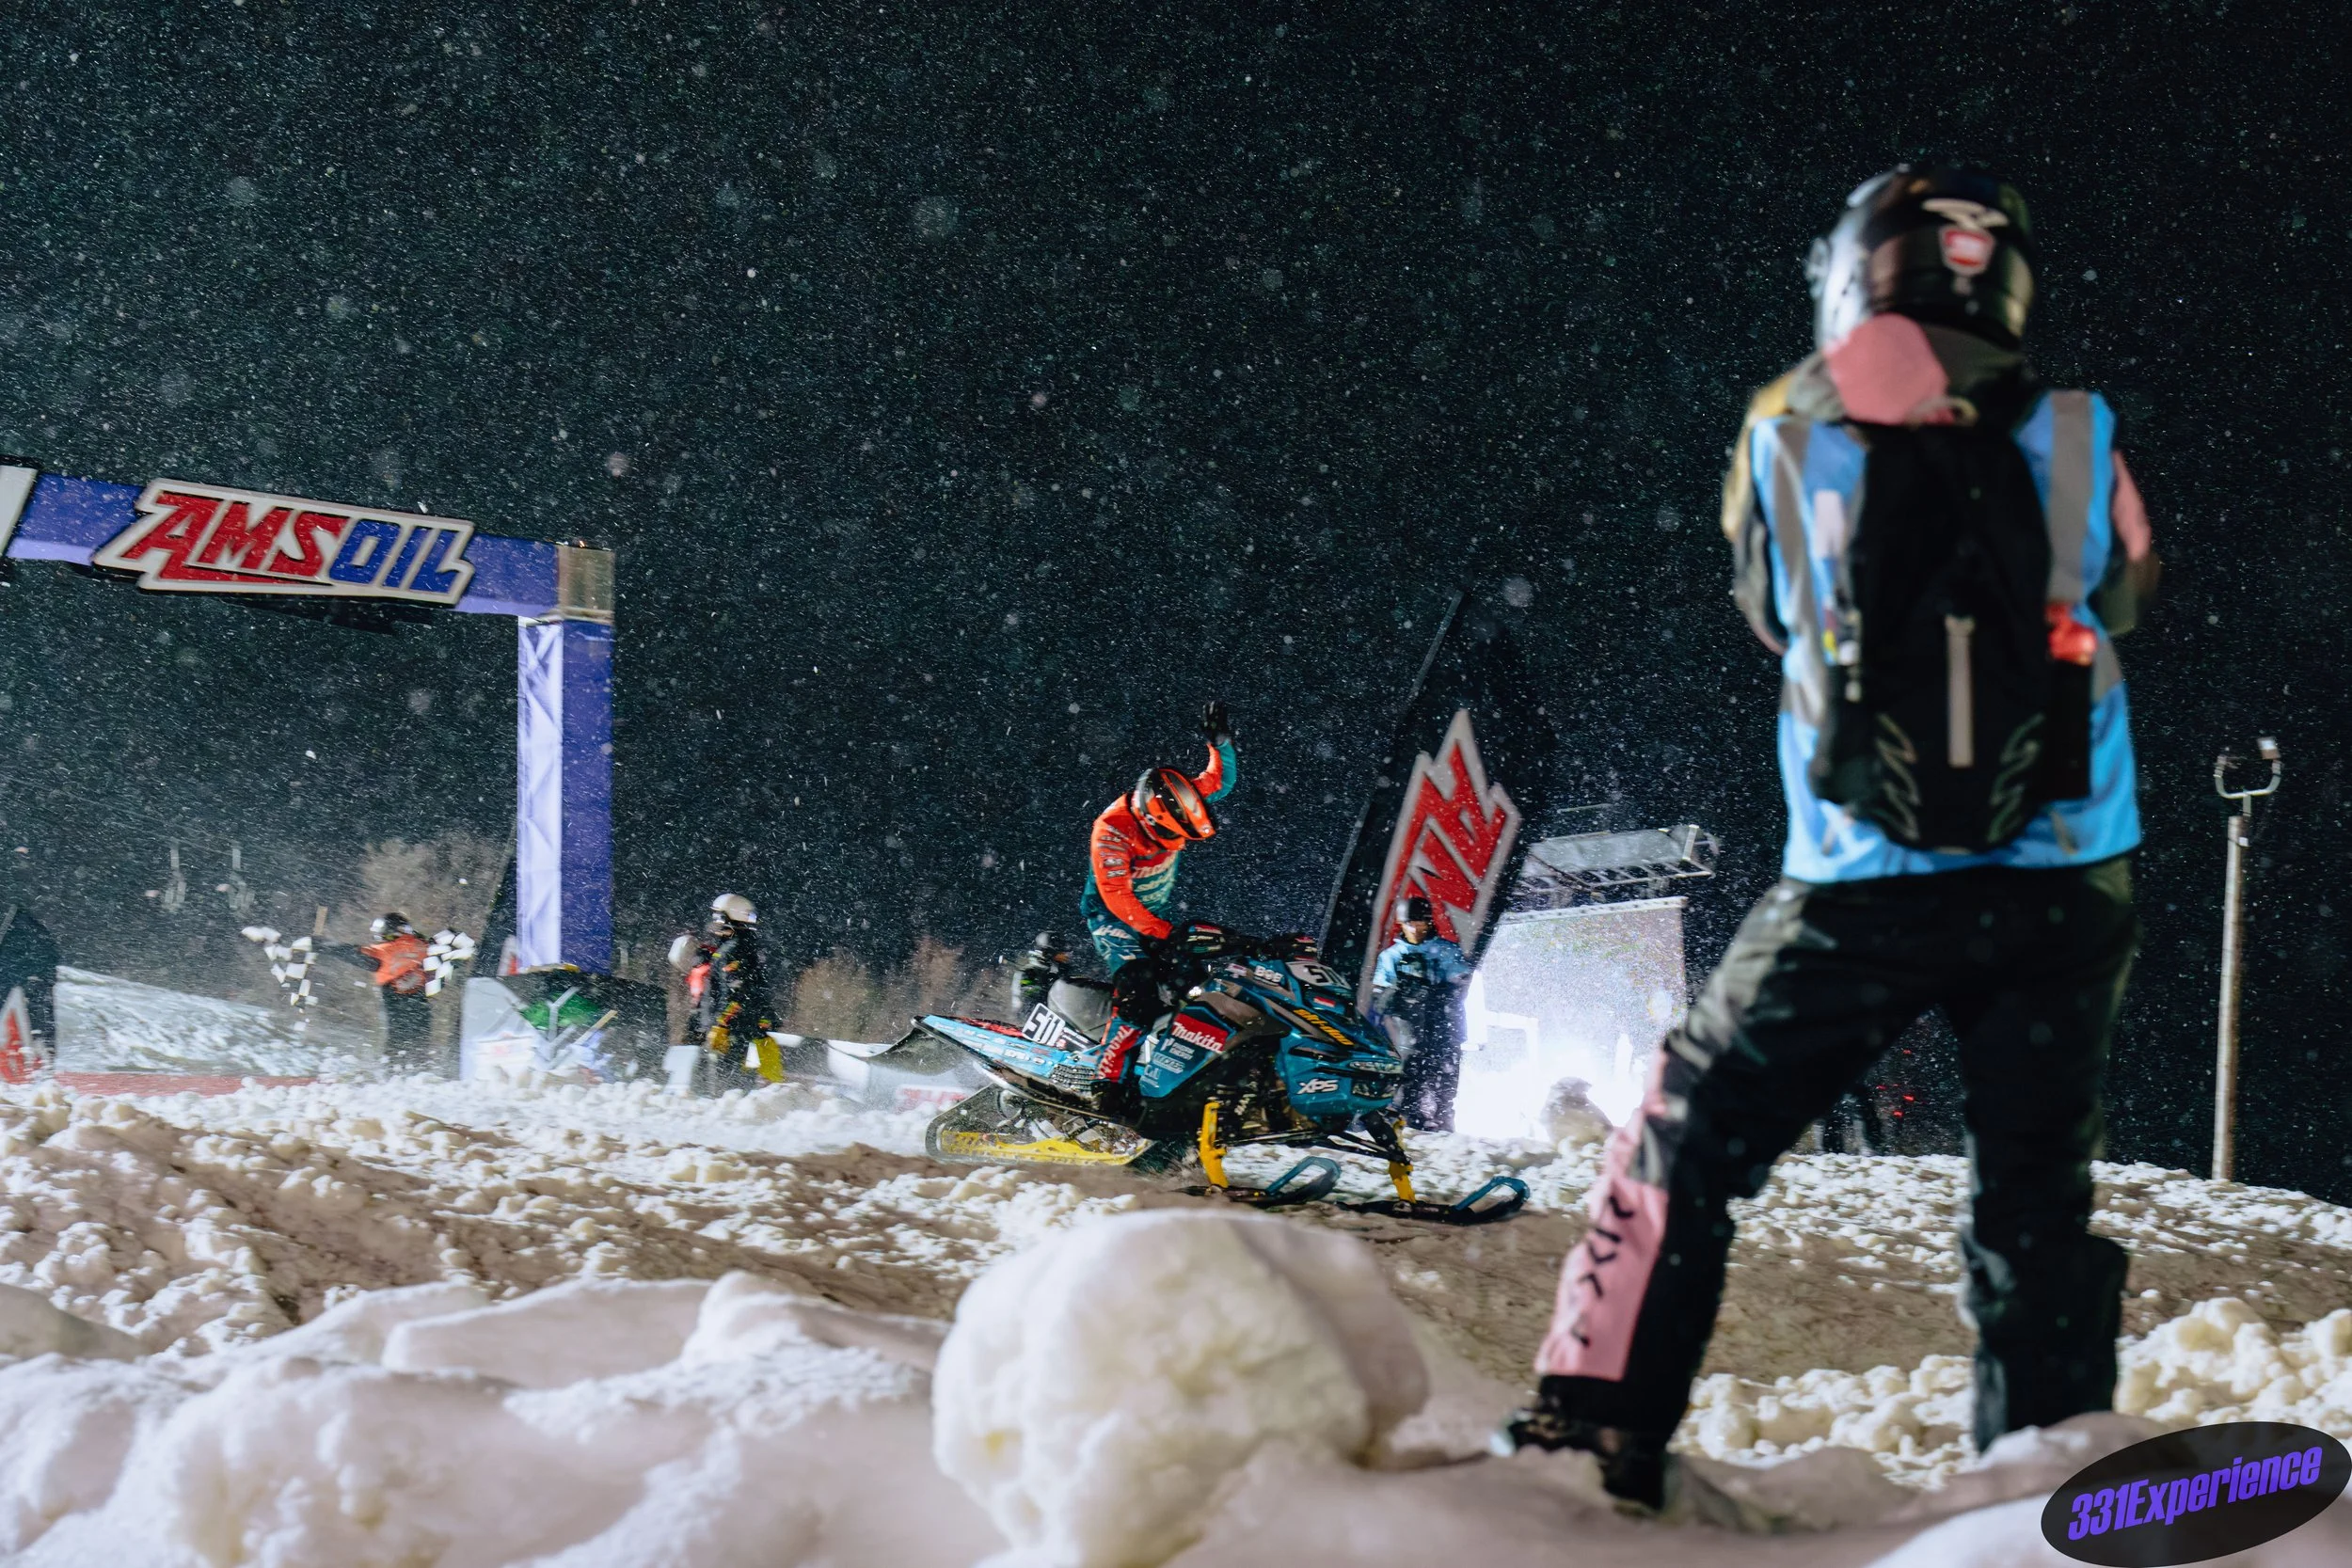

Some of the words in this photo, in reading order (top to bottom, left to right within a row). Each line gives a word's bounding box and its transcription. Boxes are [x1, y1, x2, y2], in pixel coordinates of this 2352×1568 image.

[122, 491, 457, 594] AMSOIL
[1025, 1006, 1061, 1046] 511
[1296, 1079, 1339, 1095] XPS
